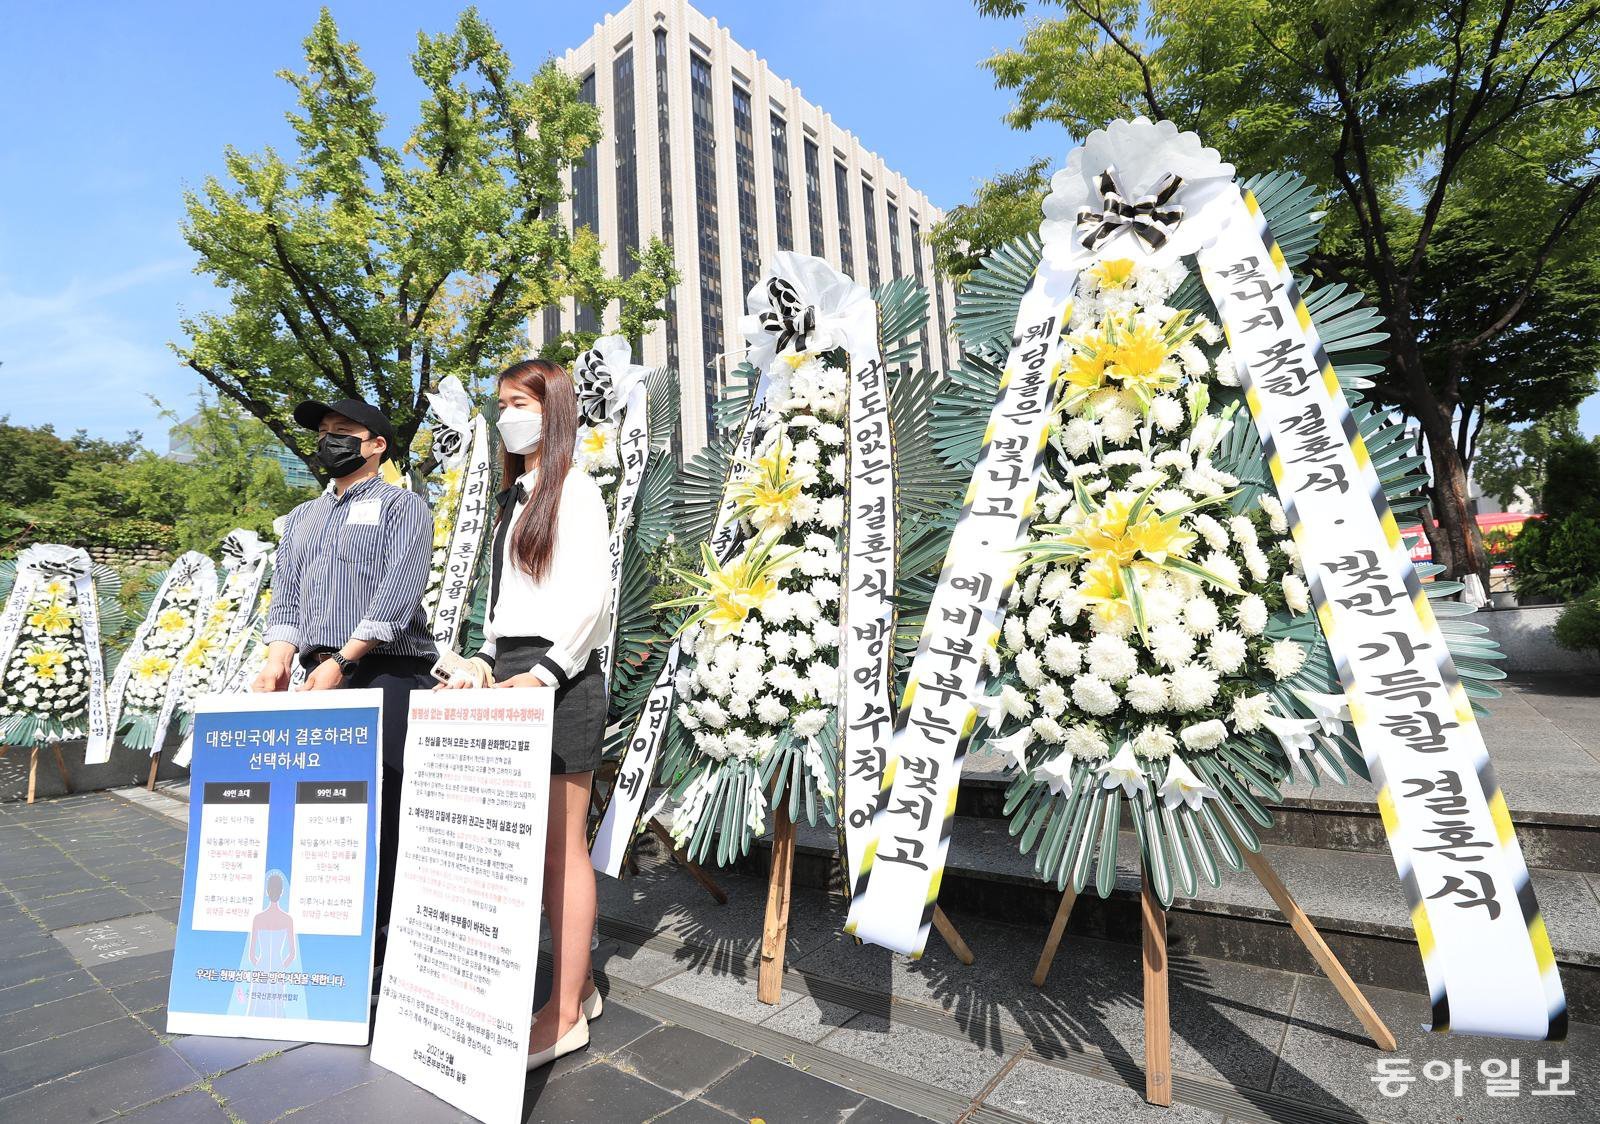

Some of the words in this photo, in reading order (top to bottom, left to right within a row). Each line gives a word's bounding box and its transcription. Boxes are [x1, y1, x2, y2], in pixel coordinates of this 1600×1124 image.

[1215, 255, 1285, 334] 빛나지
[1001, 316, 1055, 426] 웨딩홀은
[1250, 338, 1319, 397] 못한
[1279, 402, 1351, 495] 결혼식
[460, 461, 489, 535] 우리나라
[971, 435, 1029, 519] 빛나고
[445, 542, 475, 600] 혼인율
[852, 496, 891, 603] 결혼식
[911, 571, 992, 745] 예비부부는
[430, 708, 443, 720] 없는
[444, 708, 469, 720] 결혼식장
[470, 708, 490, 721] 지침에
[490, 708, 505, 721] 대해
[849, 617, 892, 792] 방역수칙
[1358, 630, 1460, 754] 가득할
[205, 728, 290, 747] 대한민국에서
[295, 726, 369, 746] 결혼하려면
[425, 736, 441, 747] 현실을
[442, 737, 453, 747] 전혀
[453, 738, 469, 748] 모르는
[470, 738, 486, 749] 조치를
[488, 739, 516, 750] 완화했다고
[518, 740, 530, 752] 발표
[249, 752, 321, 770] 선택하세요
[222, 789, 237, 798] 49인
[238, 789, 251, 798] 초대
[317, 788, 332, 797] 99인
[333, 788, 347, 797] 초대
[408, 807, 414, 816] 2.
[415, 808, 434, 819] 예식장의
[436, 810, 451, 822] 갑질에
[451, 813, 468, 825] 공정위
[469, 815, 484, 828] 권고는
[486, 818, 498, 830] 전혀
[499, 821, 518, 834] 실효성
[519, 823, 532, 836] 없어
[1402, 770, 1503, 922] 결혼식
[416, 904, 422, 914] 3.
[423, 906, 438, 920] 전국의
[439, 911, 450, 922] 예비
[451, 915, 472, 930] 부부들이
[473, 922, 490, 937] 바라는
[492, 926, 499, 939] 점
[196, 969, 219, 981] 우리는
[220, 970, 251, 983] 형평성에
[252, 971, 268, 984] 맞는
[269, 972, 309, 985] 방역지침을
[310, 974, 346, 987] 원합니다.
[426, 1043, 445, 1060] 2021년
[445, 1052, 454, 1065] 9월
[466, 1022, 495, 1041] 예비부부들이
[413, 1050, 455, 1078] 전국신혼부부연합회
[456, 1071, 466, 1085] 일동
